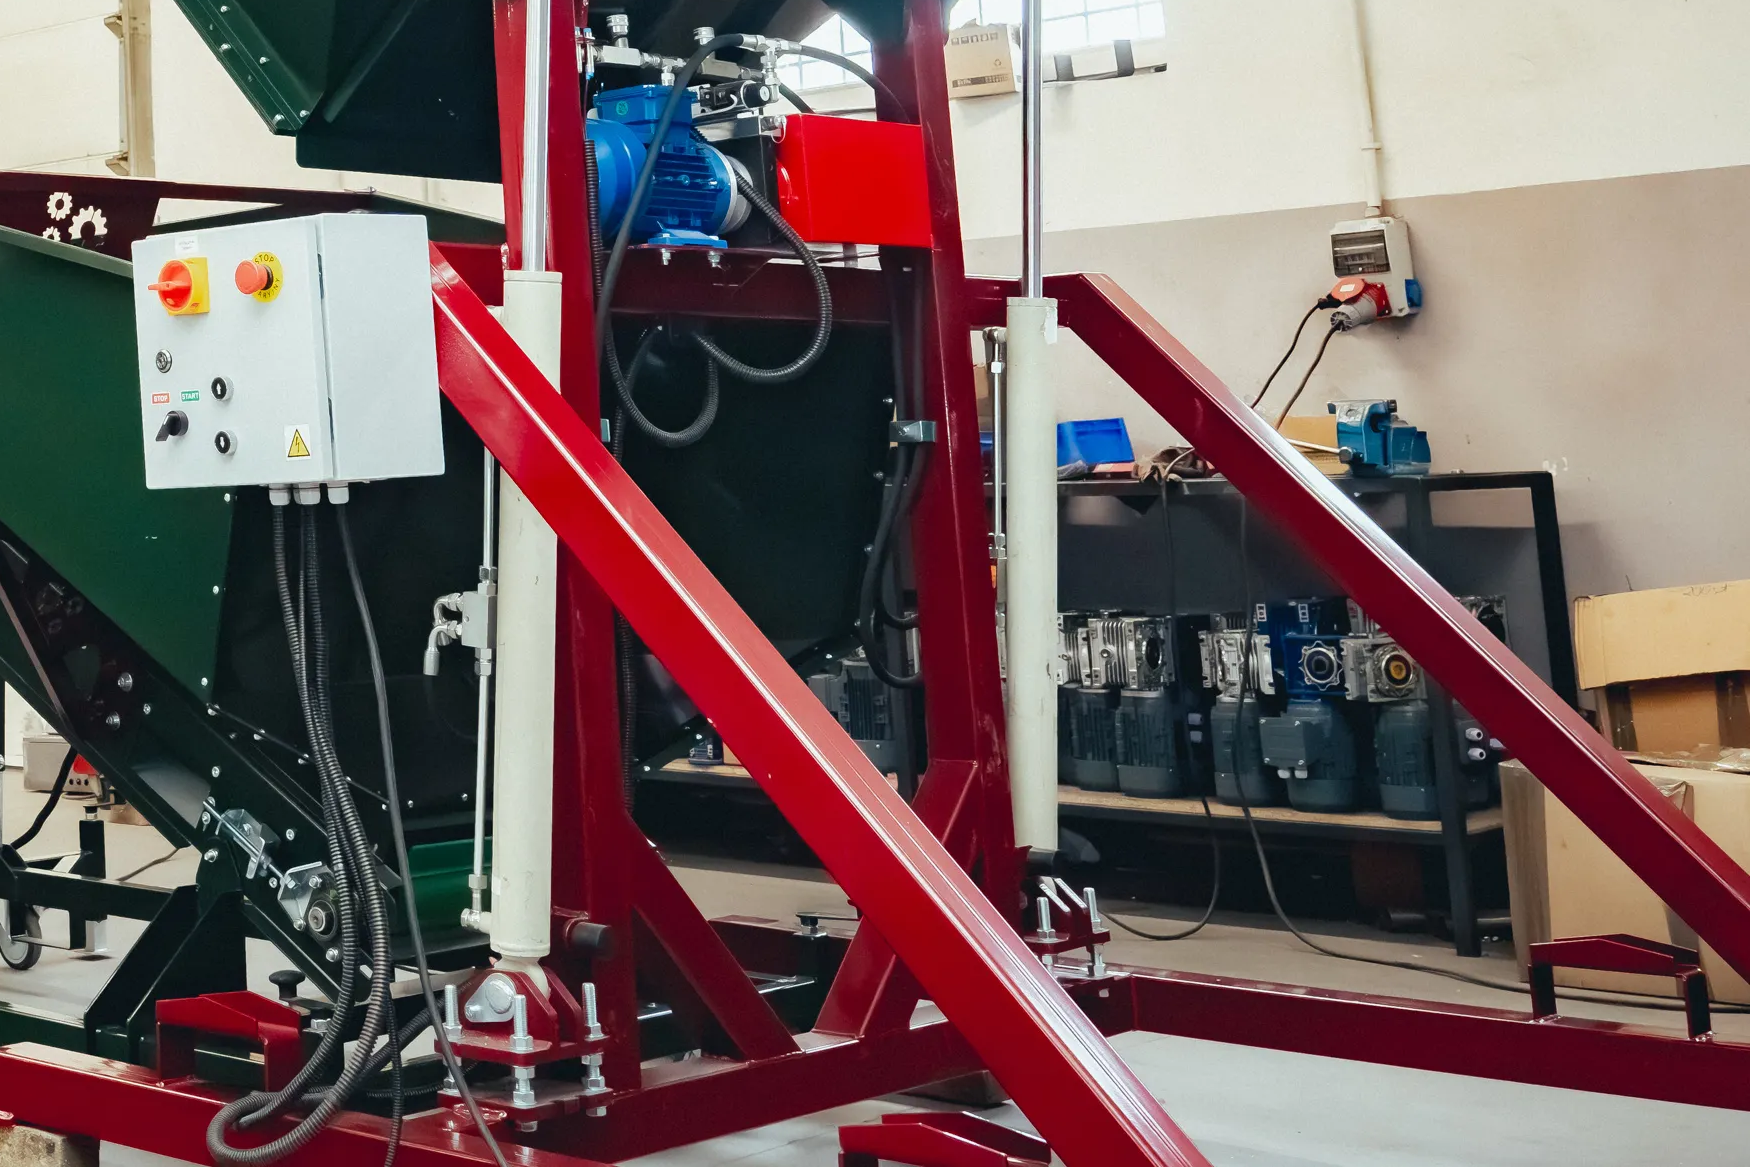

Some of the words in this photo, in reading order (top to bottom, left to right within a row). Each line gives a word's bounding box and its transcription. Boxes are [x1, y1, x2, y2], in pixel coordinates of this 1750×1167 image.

[254, 253, 275, 265] STOP
[153, 395, 168, 403] STOP
[181, 392, 199, 400] START
